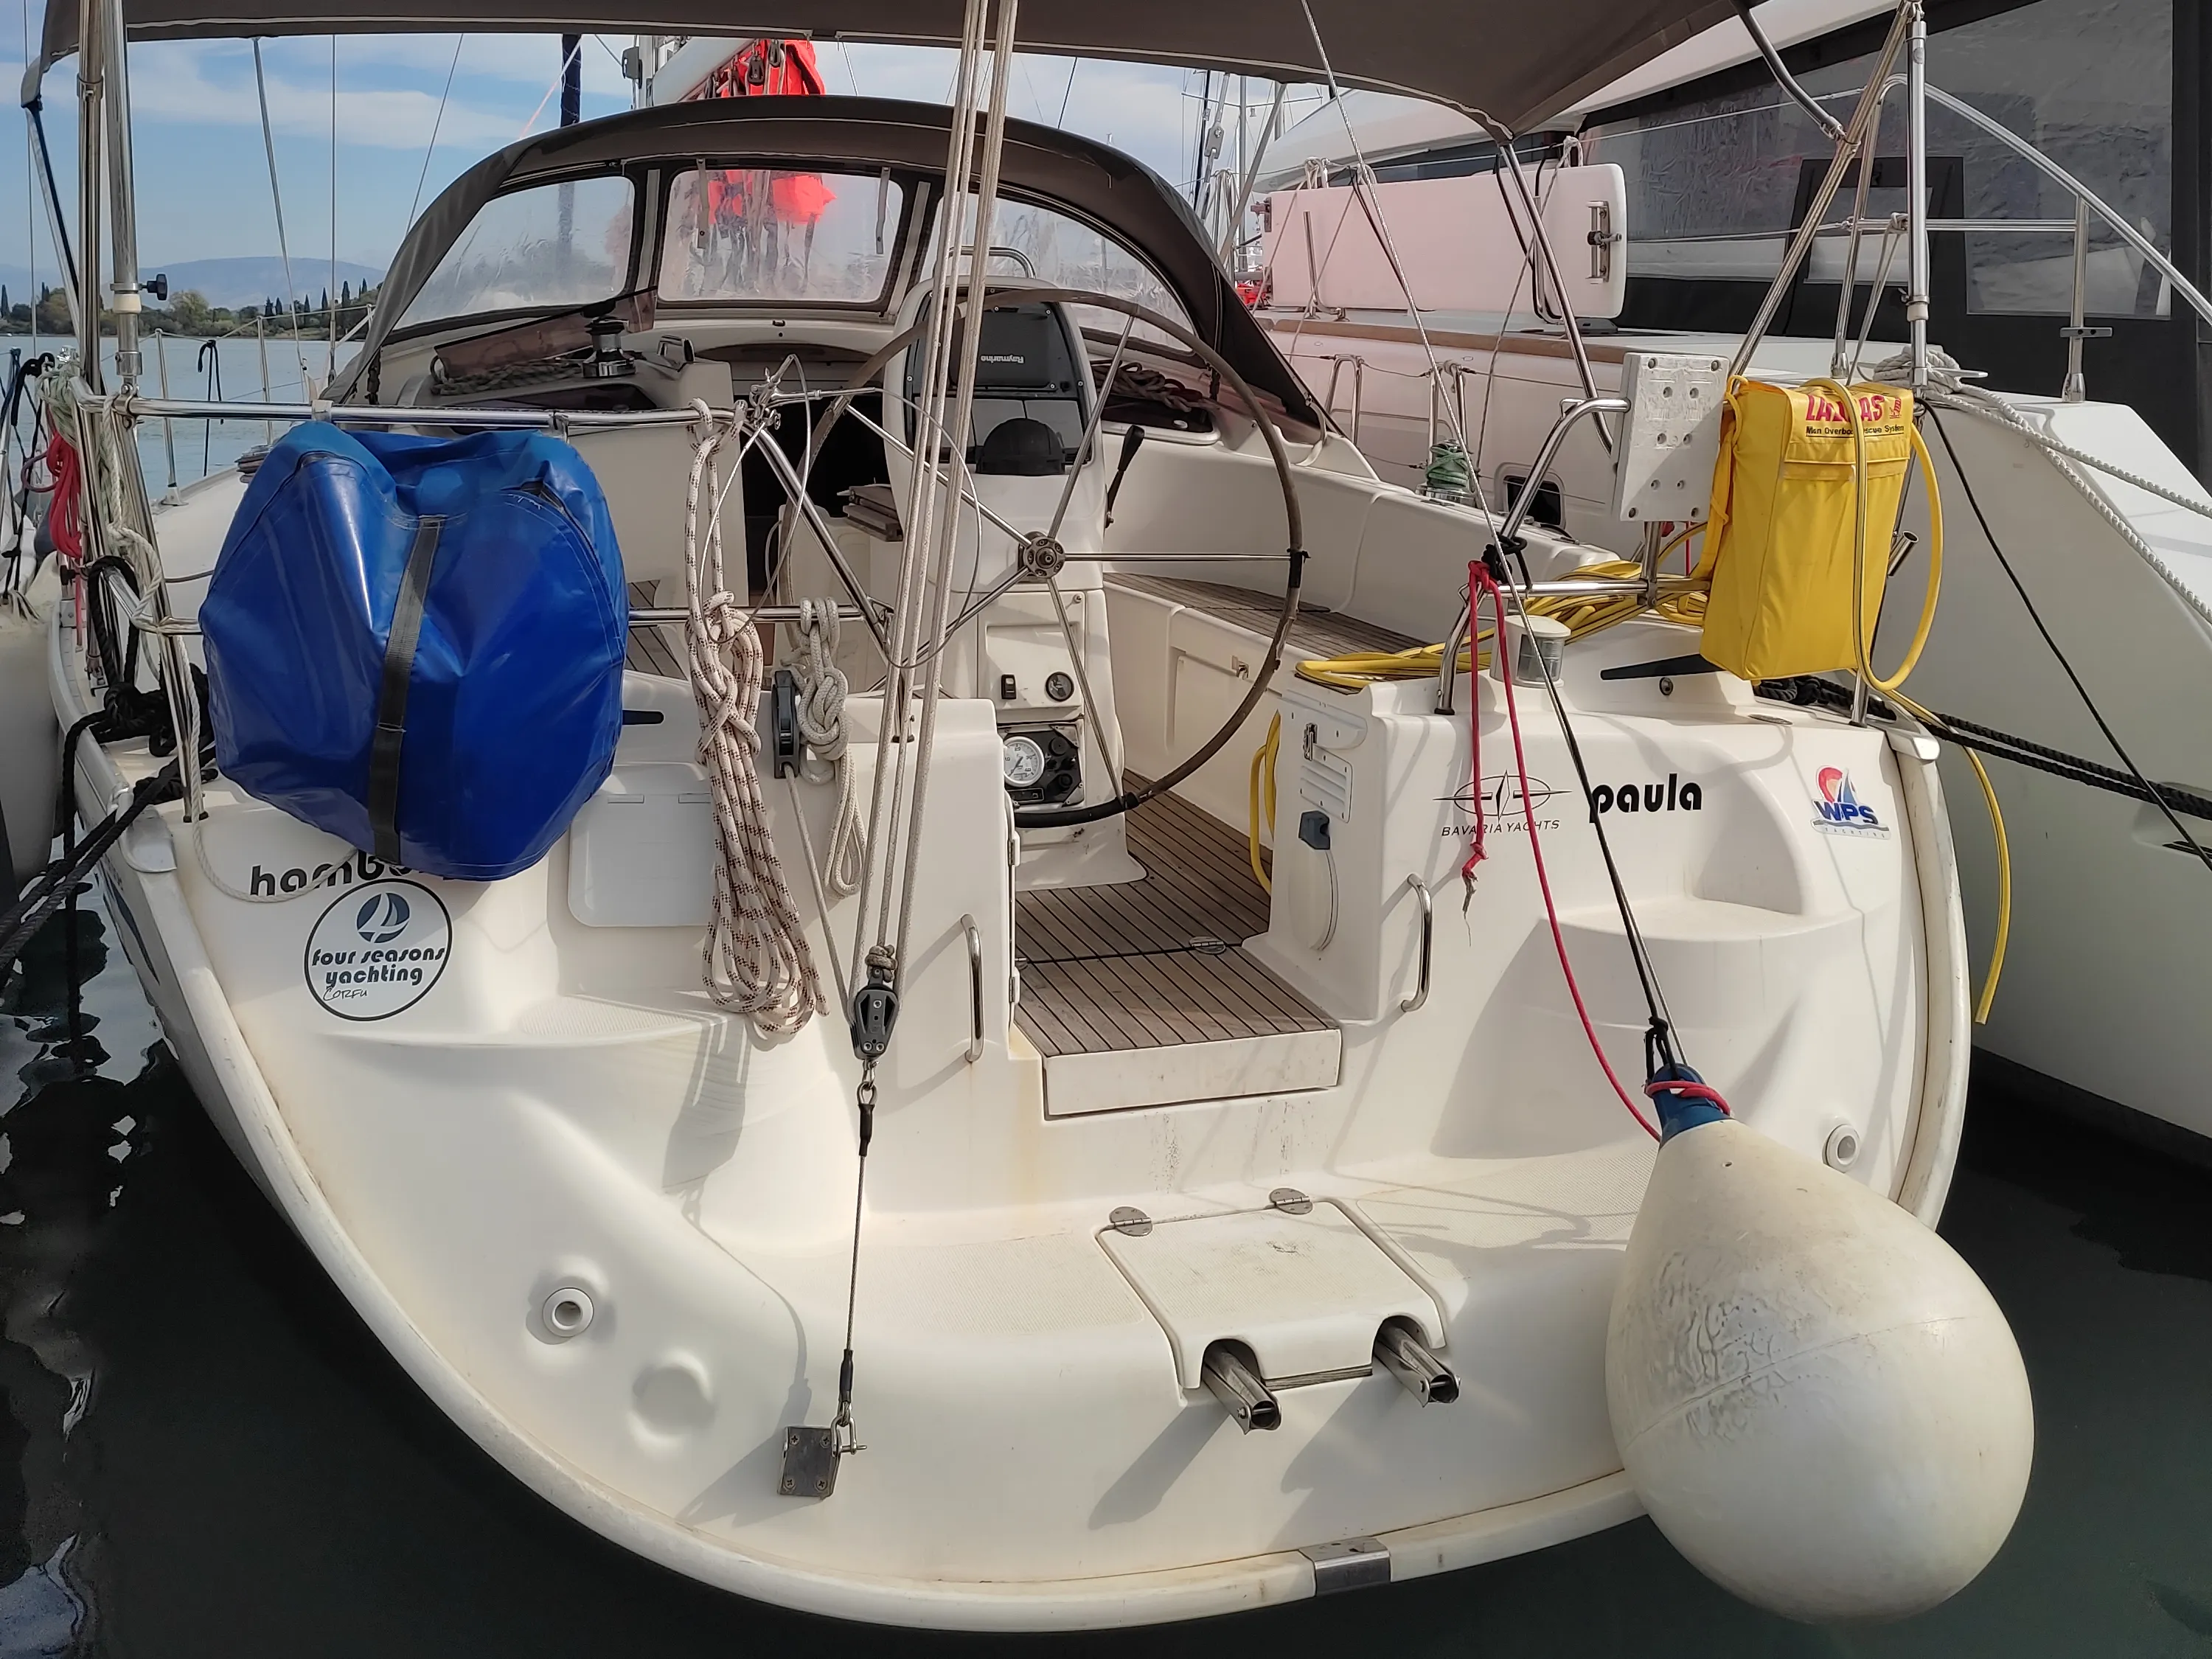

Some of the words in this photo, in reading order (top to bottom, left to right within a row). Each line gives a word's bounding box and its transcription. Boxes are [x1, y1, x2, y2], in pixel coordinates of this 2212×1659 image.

[980, 355, 1024, 364] Raymarine
[1589, 773, 1702, 823] paula
[1813, 800, 1879, 825] WPS
[312, 948, 356, 967] four
[360, 947, 445, 964] seasons
[325, 964, 423, 990] yachting
